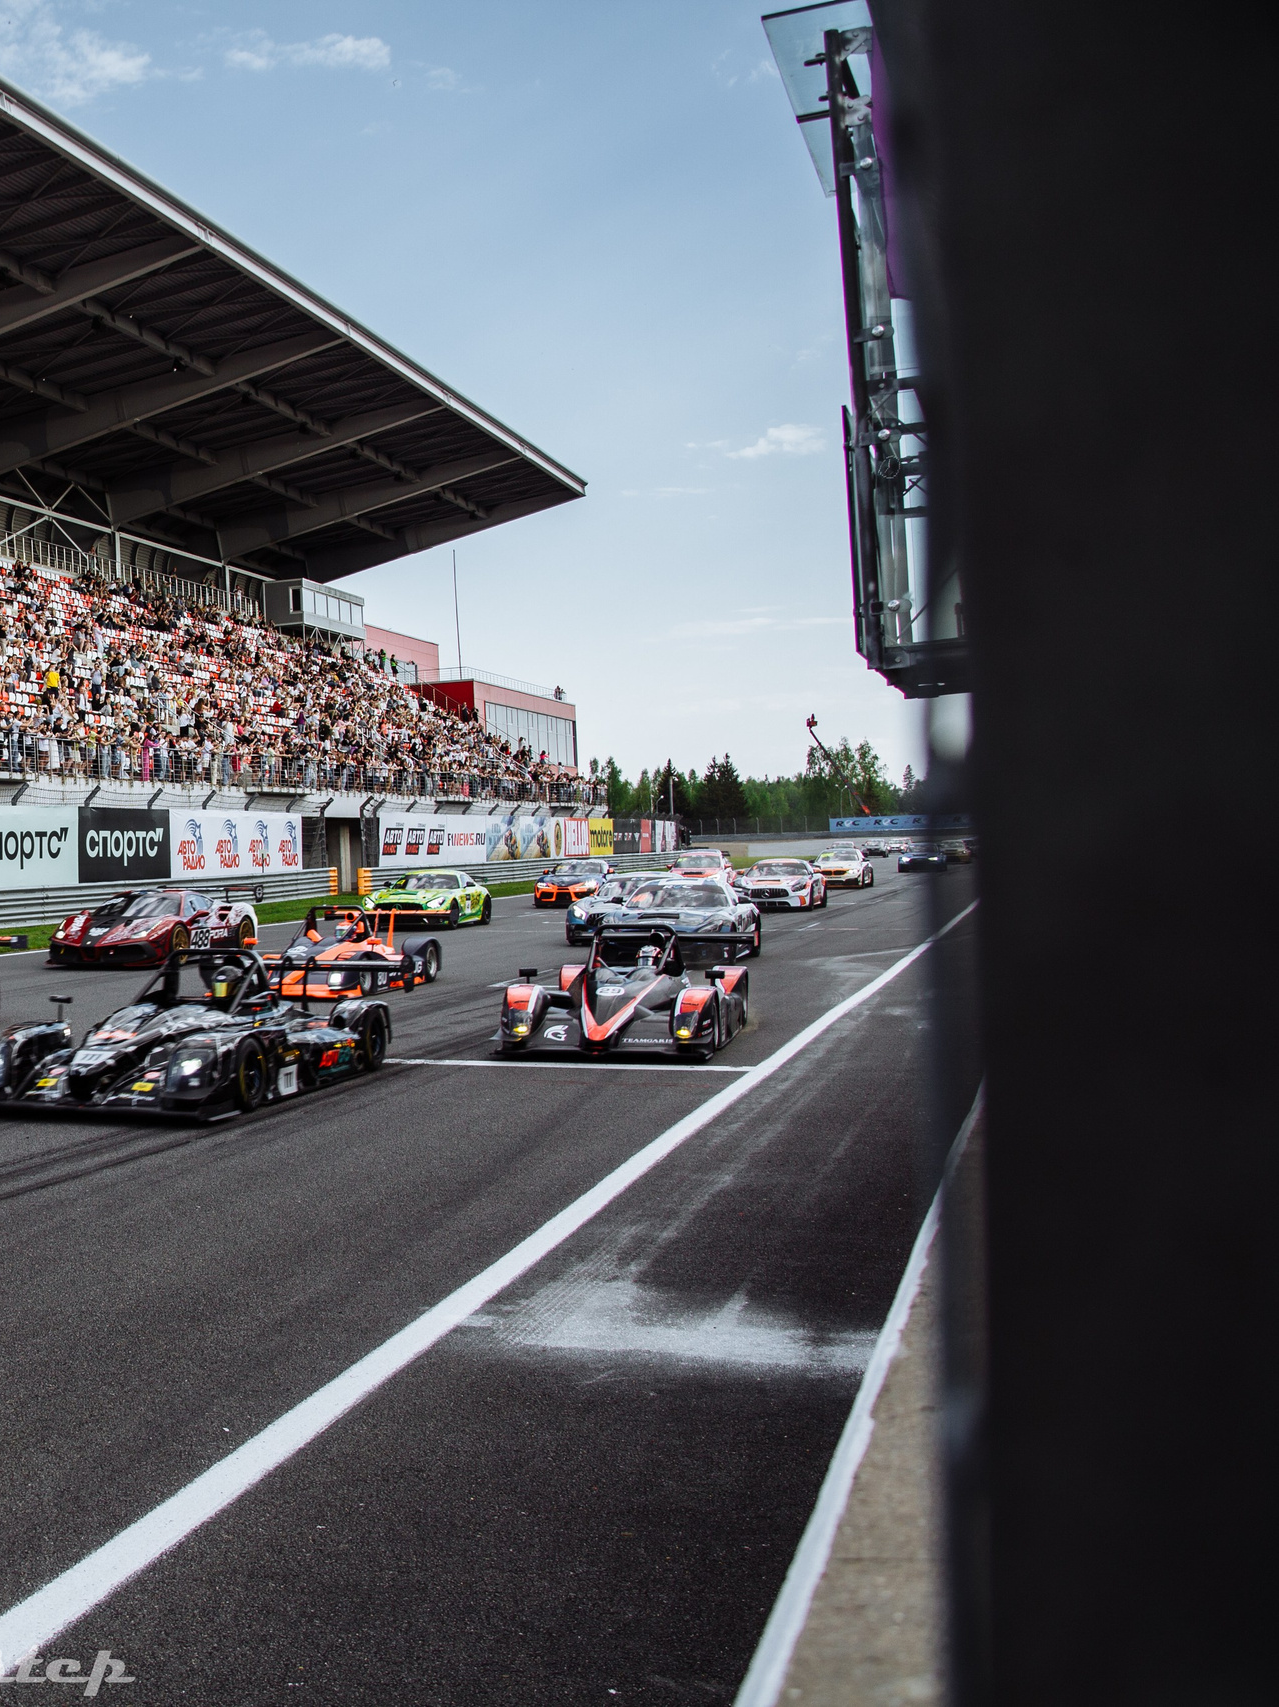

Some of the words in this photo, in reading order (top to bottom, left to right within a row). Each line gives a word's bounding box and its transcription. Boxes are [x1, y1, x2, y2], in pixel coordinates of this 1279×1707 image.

[384, 829, 403, 844] АВТО
[406, 829, 425, 844] АВТО
[428, 830, 444, 844] АВТО
[447, 832, 486, 847] F1NEWS.RU
[177, 840, 196, 855] АВТО
[215, 839, 232, 854] АВТО
[248, 839, 263, 853] АВТО
[278, 839, 292, 853] АВТО
[183, 855, 205, 870] РАДИО
[220, 853, 240, 868] РАДИО
[282, 853, 299, 866] РАДИО
[191, 929, 210, 948] 488
